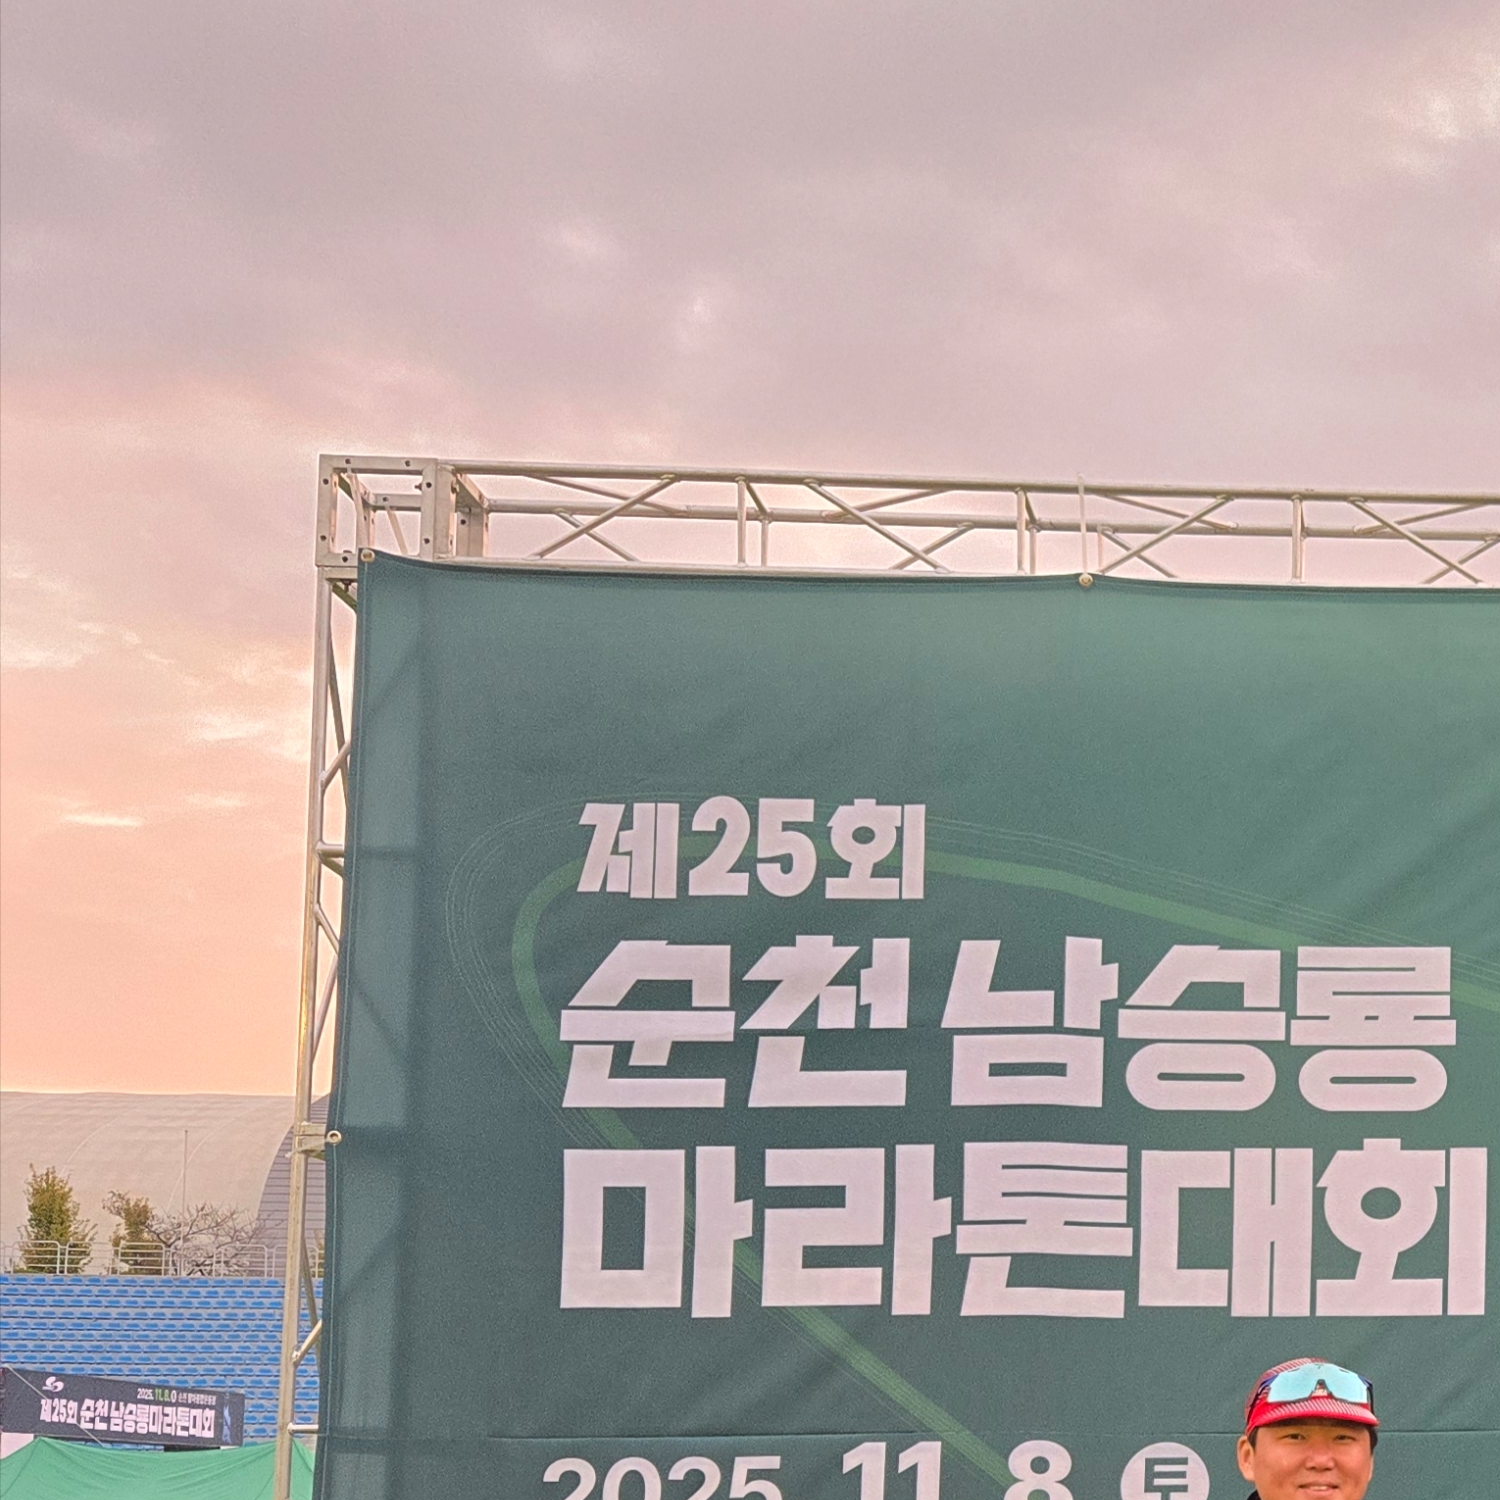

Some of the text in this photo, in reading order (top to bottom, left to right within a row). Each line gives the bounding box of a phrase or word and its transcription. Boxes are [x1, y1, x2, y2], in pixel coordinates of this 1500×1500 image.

[576, 795, 926, 900] 제25회
[559, 934, 1458, 1112] 순천 남승룡
[559, 1137, 1488, 1319] 마라톤대회
[40, 1398, 78, 1424] 제25회
[80, 1398, 108, 1430] 순천
